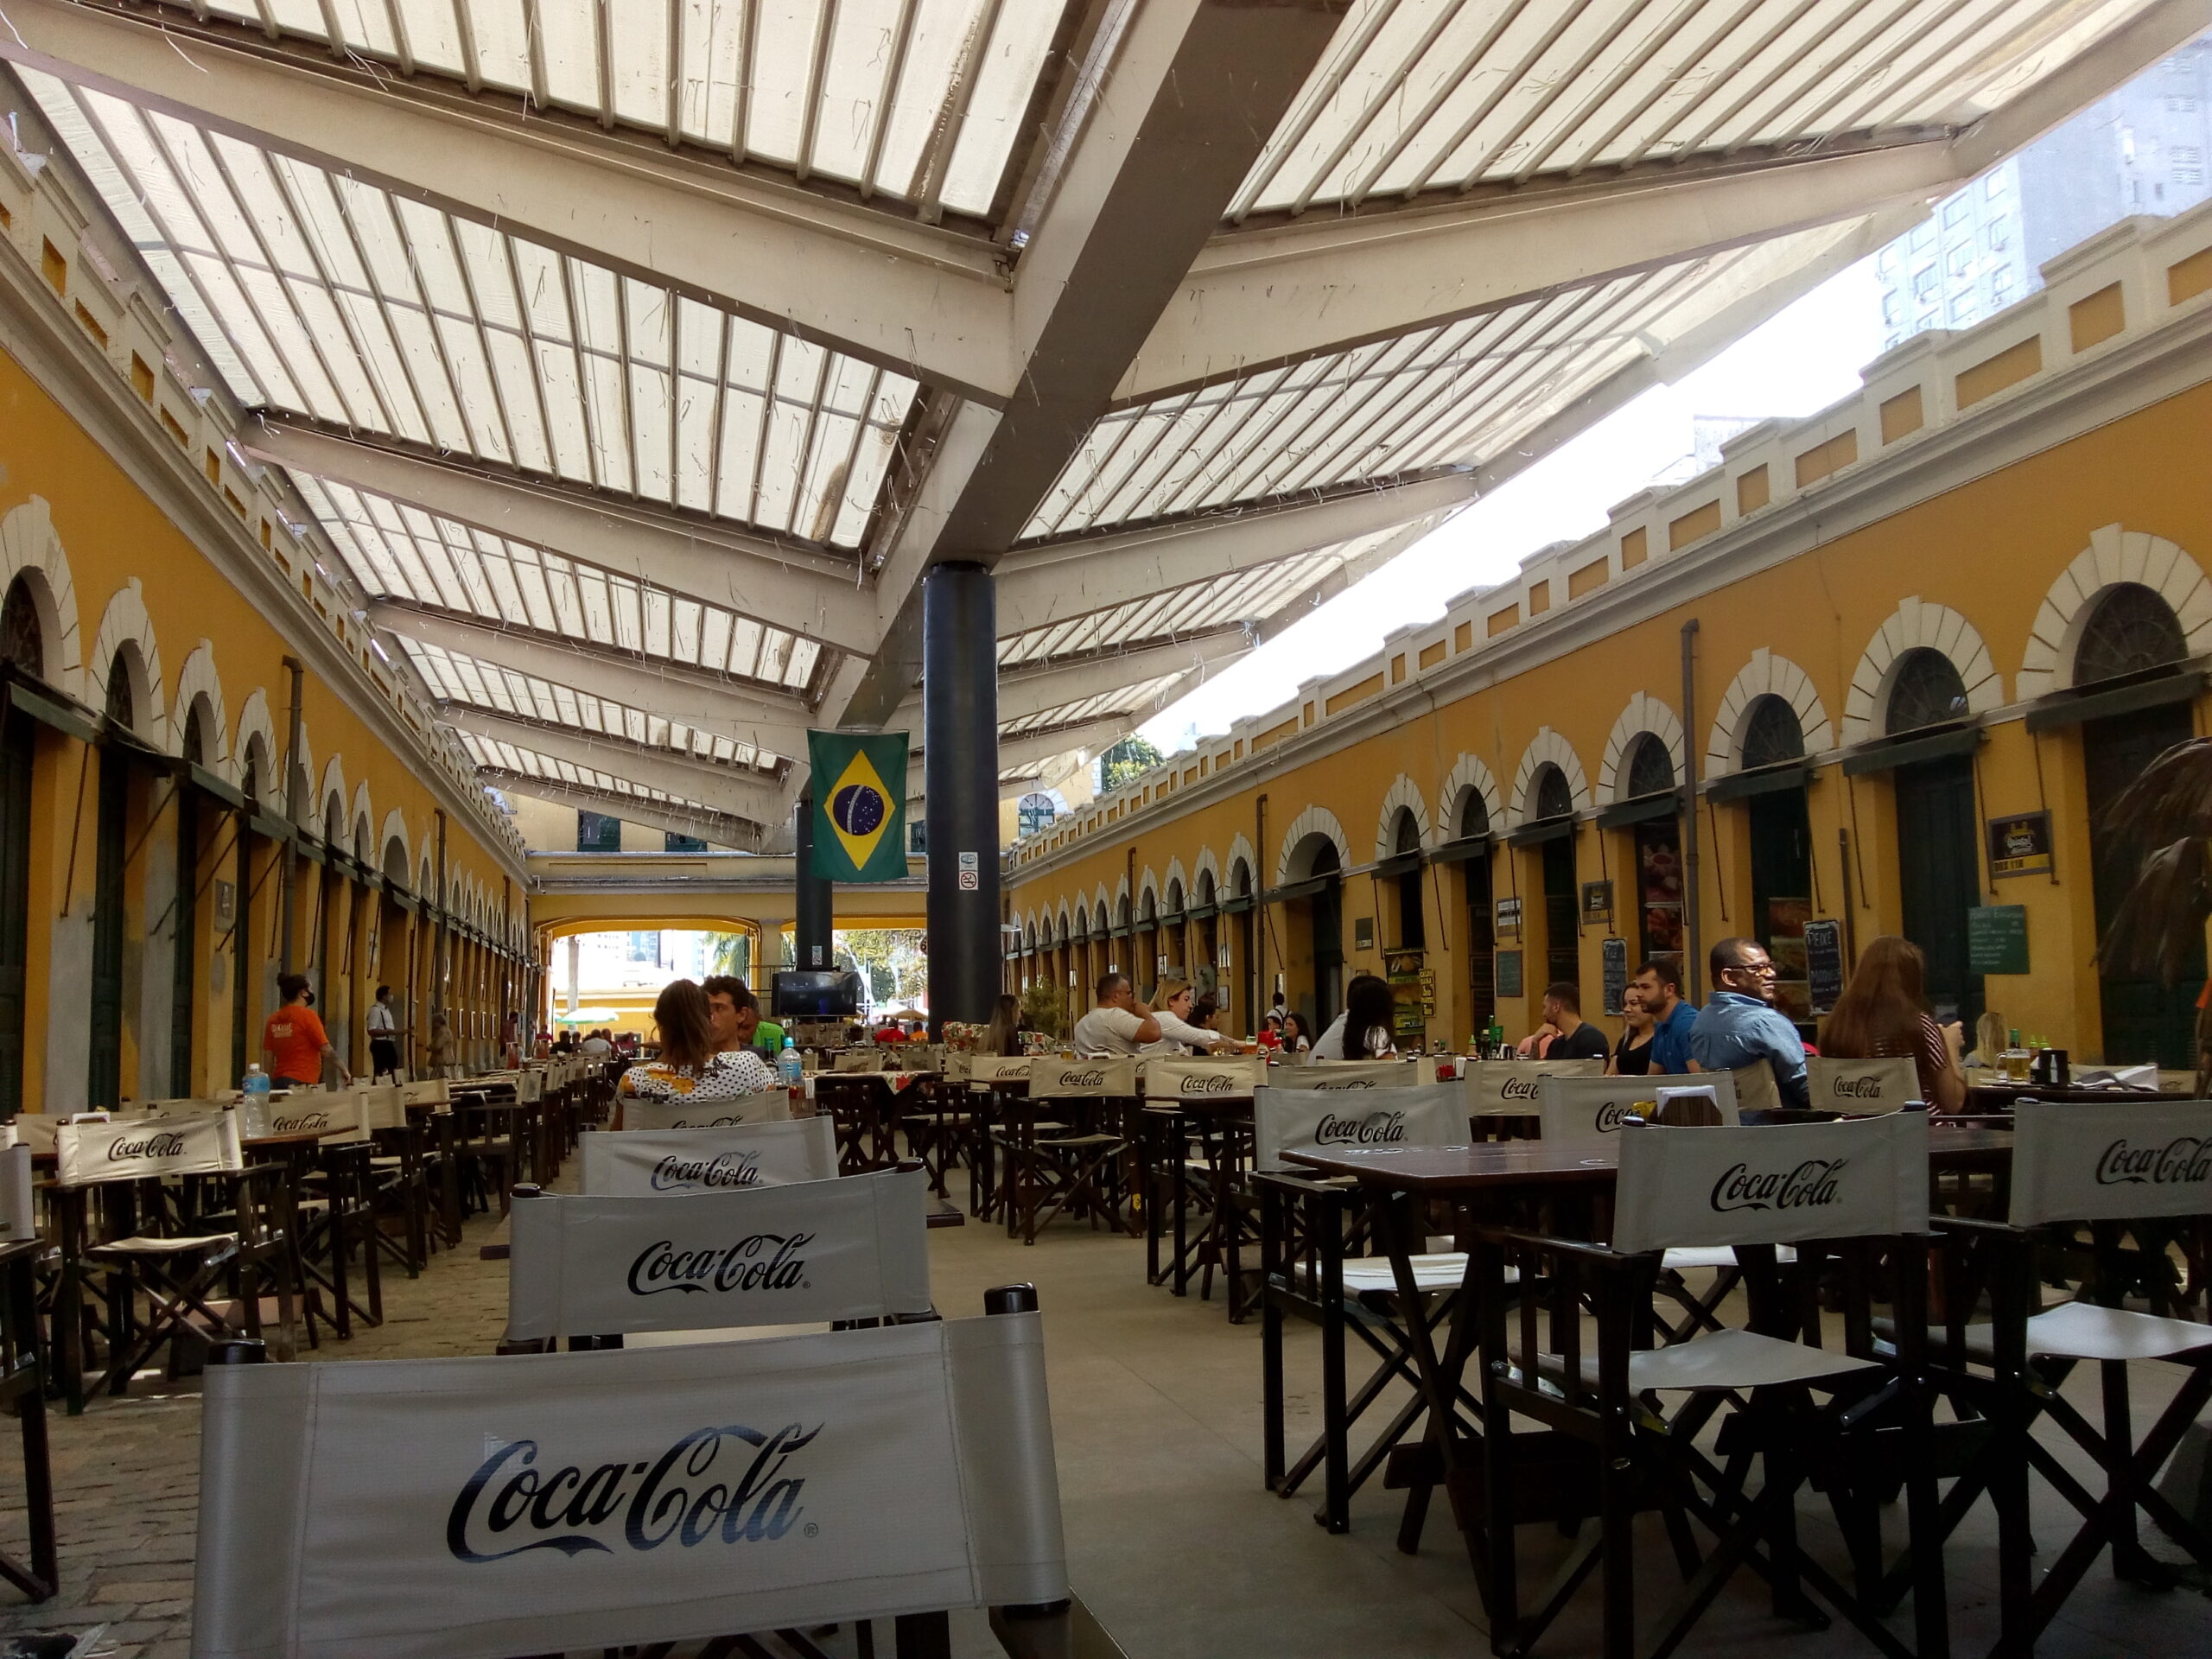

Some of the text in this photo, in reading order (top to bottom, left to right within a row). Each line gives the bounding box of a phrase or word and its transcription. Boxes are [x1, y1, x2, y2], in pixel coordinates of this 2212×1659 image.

[1059, 1071, 1105, 1086] Coca-Cola
[1180, 1074, 1234, 1093] Coca-Cola
[1834, 1075, 1882, 1098] Coca-Cola
[273, 1112, 330, 1131] Coca-Cola
[1315, 1111, 1407, 1146] Coca-Cola
[108, 1132, 185, 1161] Coca-Cola
[651, 1150, 763, 1191] Coca-Cola
[1710, 1159, 1850, 1212] Coca-Cola
[627, 1232, 816, 1296] Coca-Cola
[447, 1421, 825, 1564] Coca-Cola
